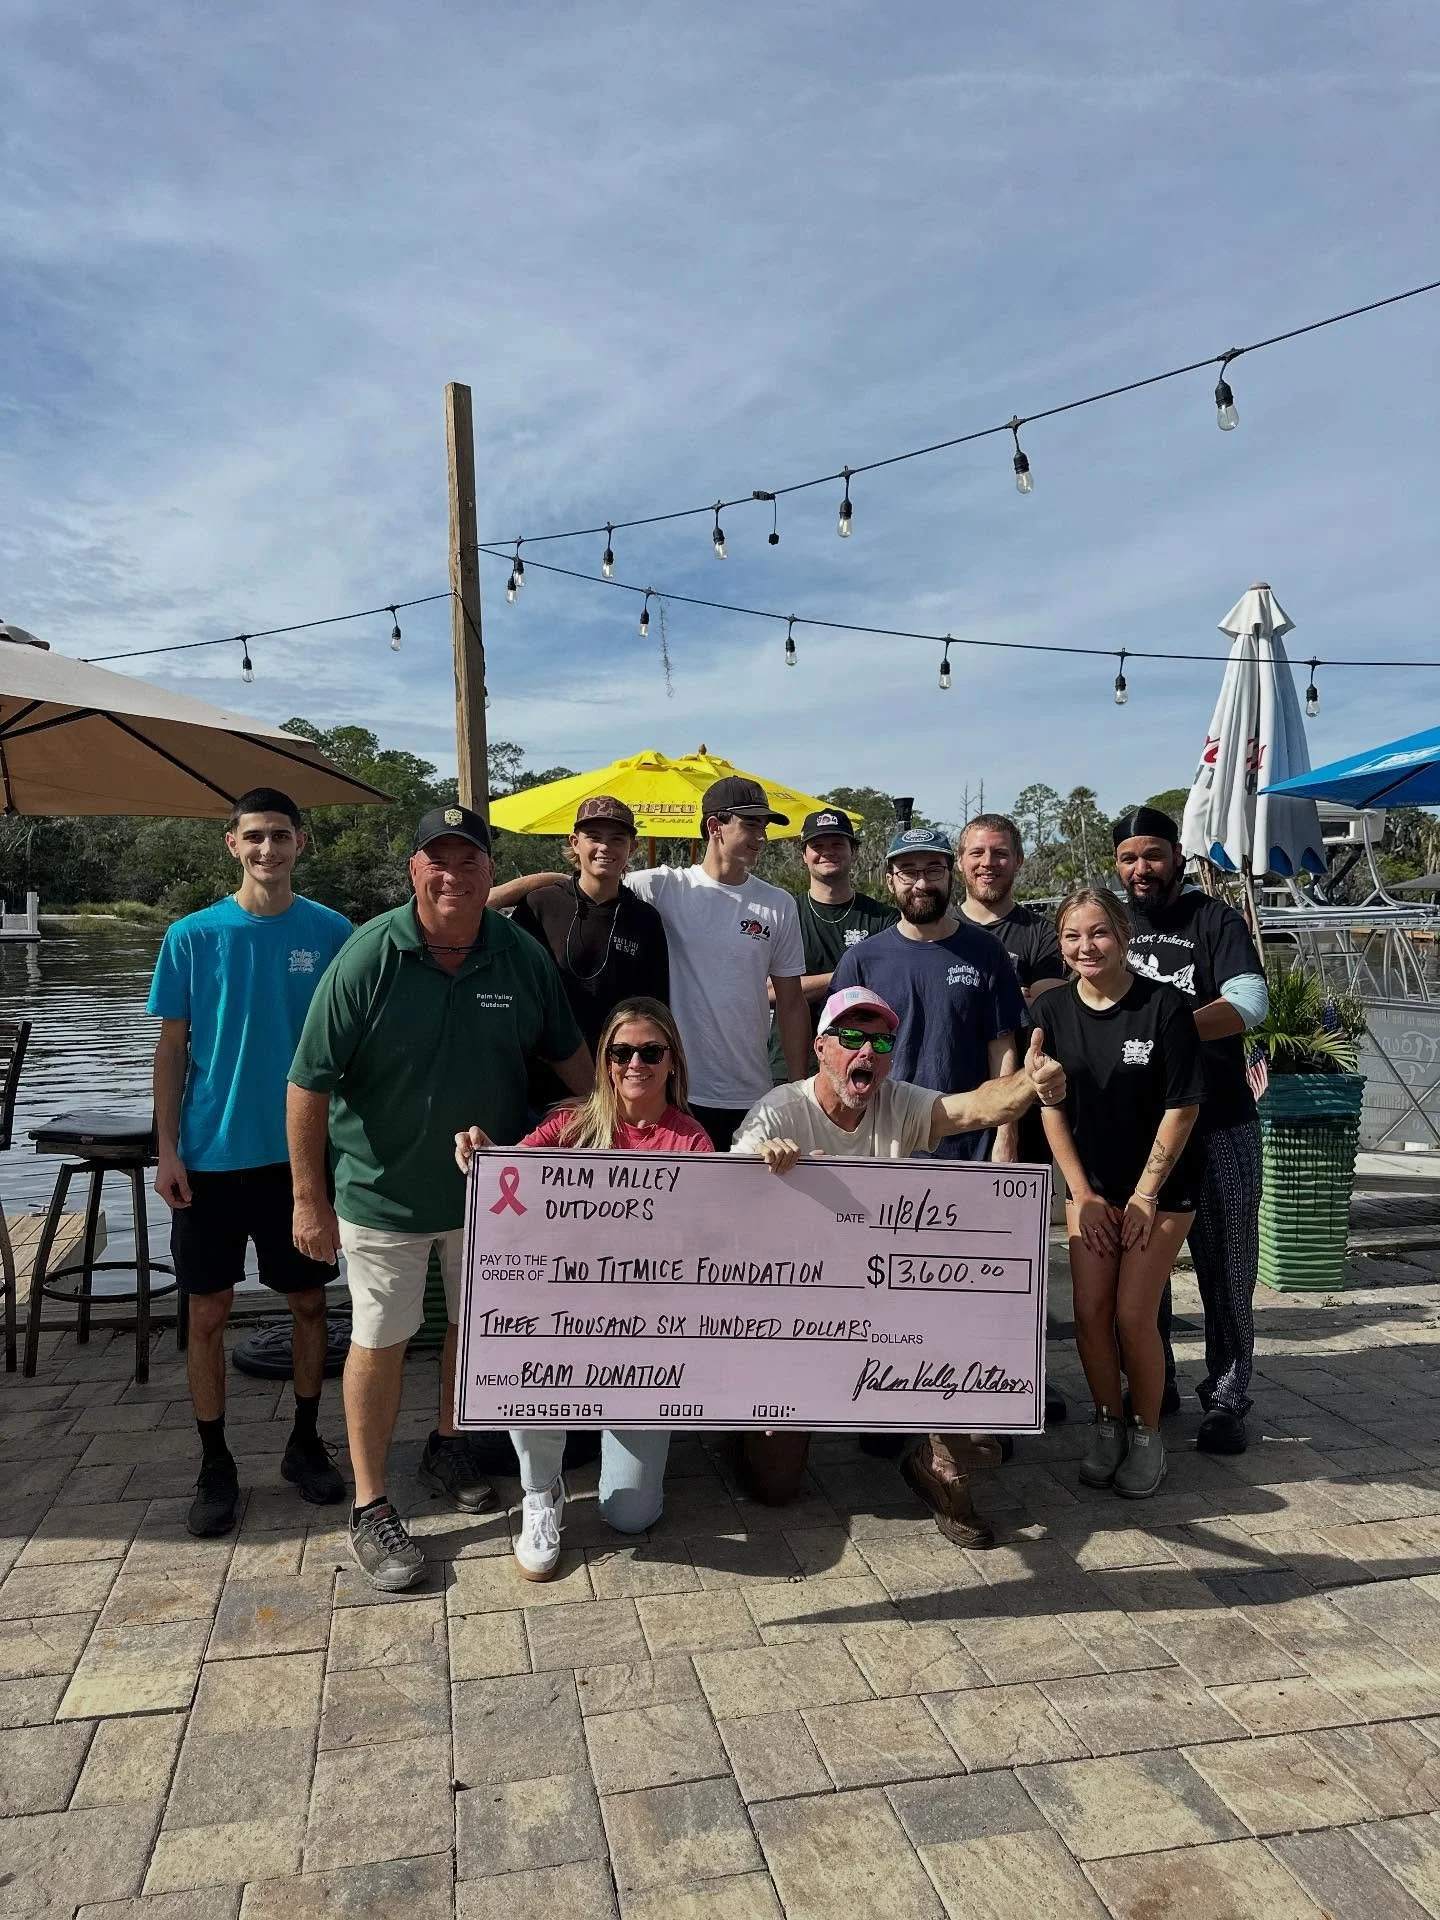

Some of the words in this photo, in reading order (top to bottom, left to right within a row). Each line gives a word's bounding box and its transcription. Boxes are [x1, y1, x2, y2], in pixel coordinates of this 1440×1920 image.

[480, 1001, 511, 1009] Outdoors
[541, 1165, 594, 1188] PALM
[608, 1165, 681, 1192] VALLEY
[992, 1179, 1038, 1199] 1001
[545, 1198, 654, 1220] OUTDOORS
[836, 1213, 865, 1224] DATE
[878, 1188, 958, 1234] 11/8/25
[480, 1254, 502, 1266] PAY
[505, 1255, 521, 1267] TO
[524, 1255, 548, 1267] THE
[552, 1256, 589, 1282] TWO
[597, 1256, 684, 1282] TITMICE
[697, 1257, 824, 1284] FOUNDATION
[481, 1270, 526, 1281] ORDER
[528, 1270, 545, 1281] OF
[480, 1308, 540, 1336] THREE
[551, 1310, 647, 1336] THOUSAND
[656, 1315, 687, 1335] SIX
[699, 1314, 782, 1338] HUNDRED
[792, 1318, 872, 1339] DOLLARS
[871, 1333, 924, 1345] DOLLARS
[475, 1374, 519, 1386] MEMO
[521, 1360, 573, 1387] BCAM
[585, 1362, 686, 1387] DONATION
[852, 1358, 910, 1402] Palm
